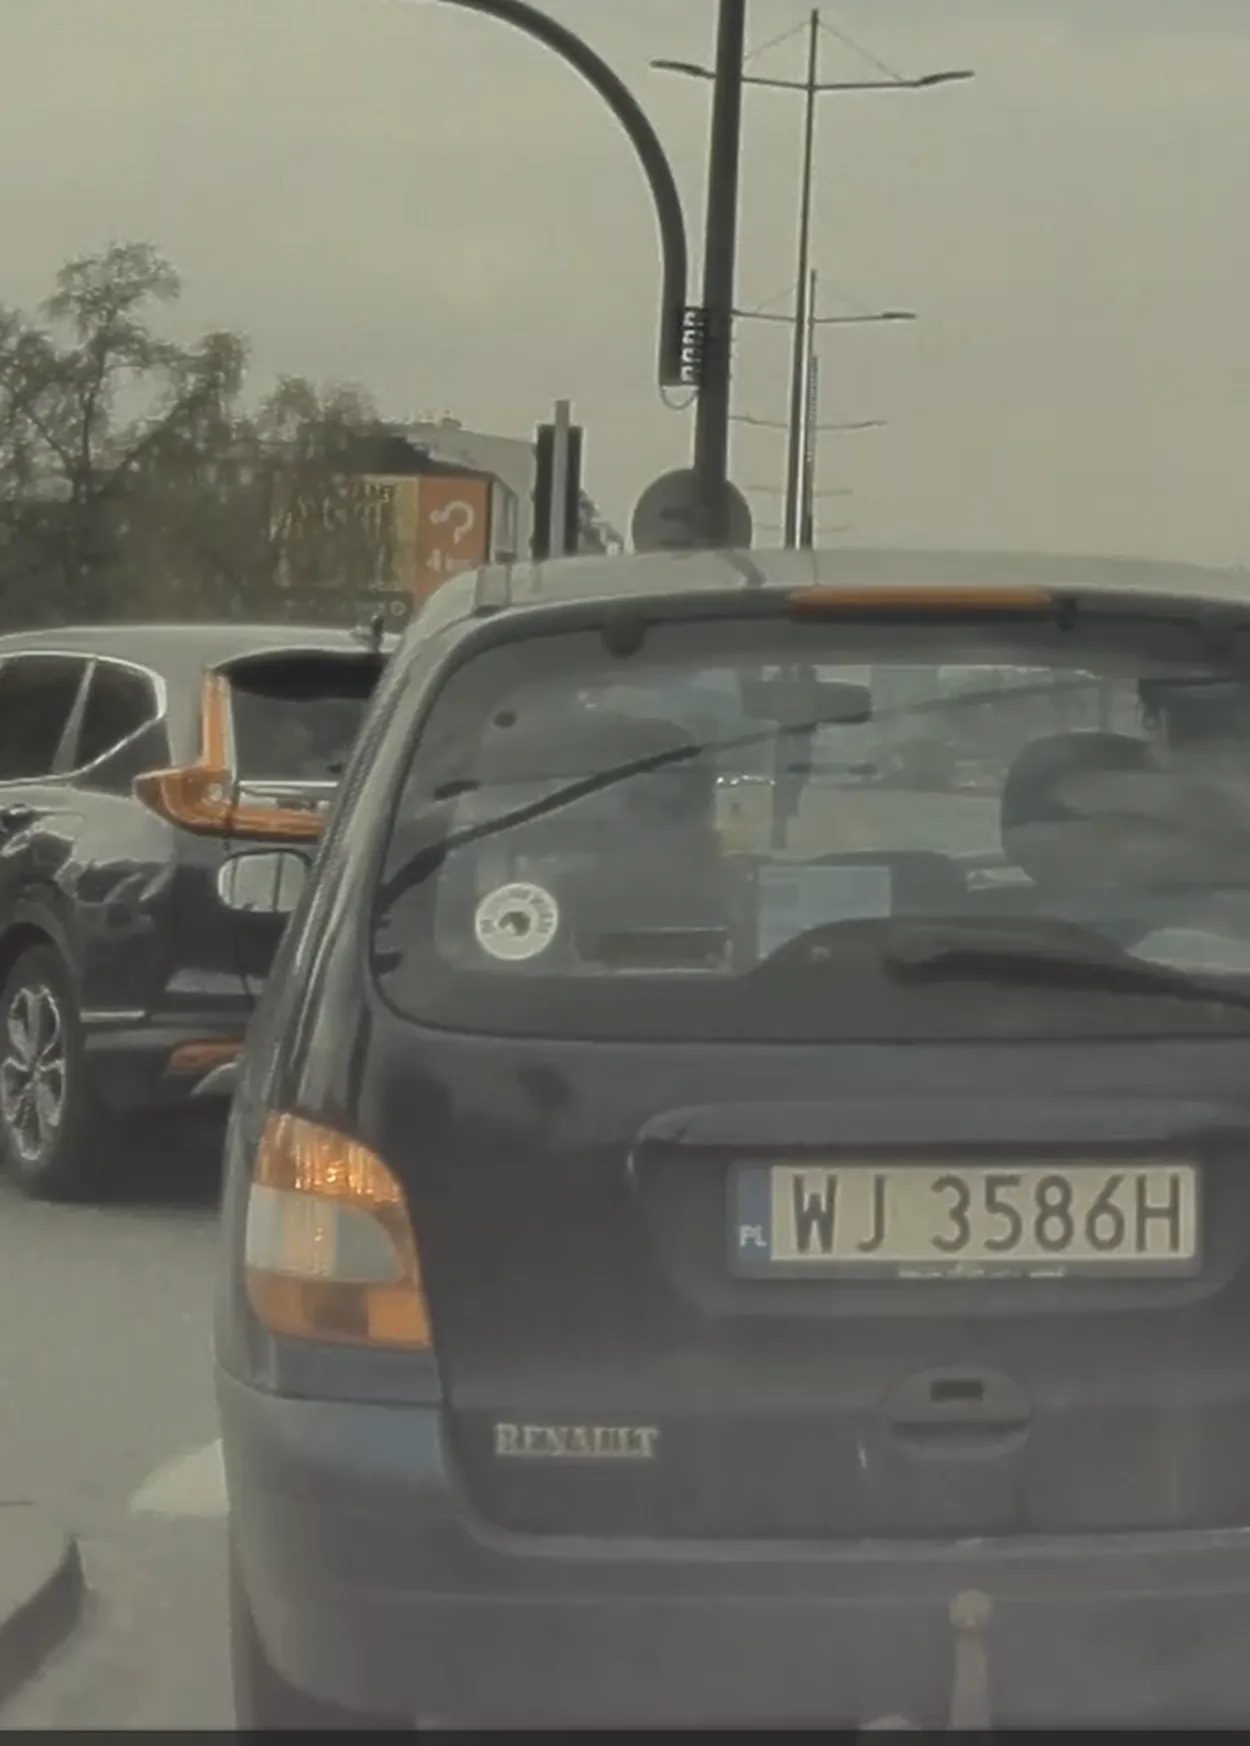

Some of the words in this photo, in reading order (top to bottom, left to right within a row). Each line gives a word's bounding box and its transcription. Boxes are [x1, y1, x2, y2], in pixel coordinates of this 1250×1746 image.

[738, 1224, 768, 1248] PL
[792, 1173, 887, 1254] WJ
[929, 1173, 1181, 1252] 3586H
